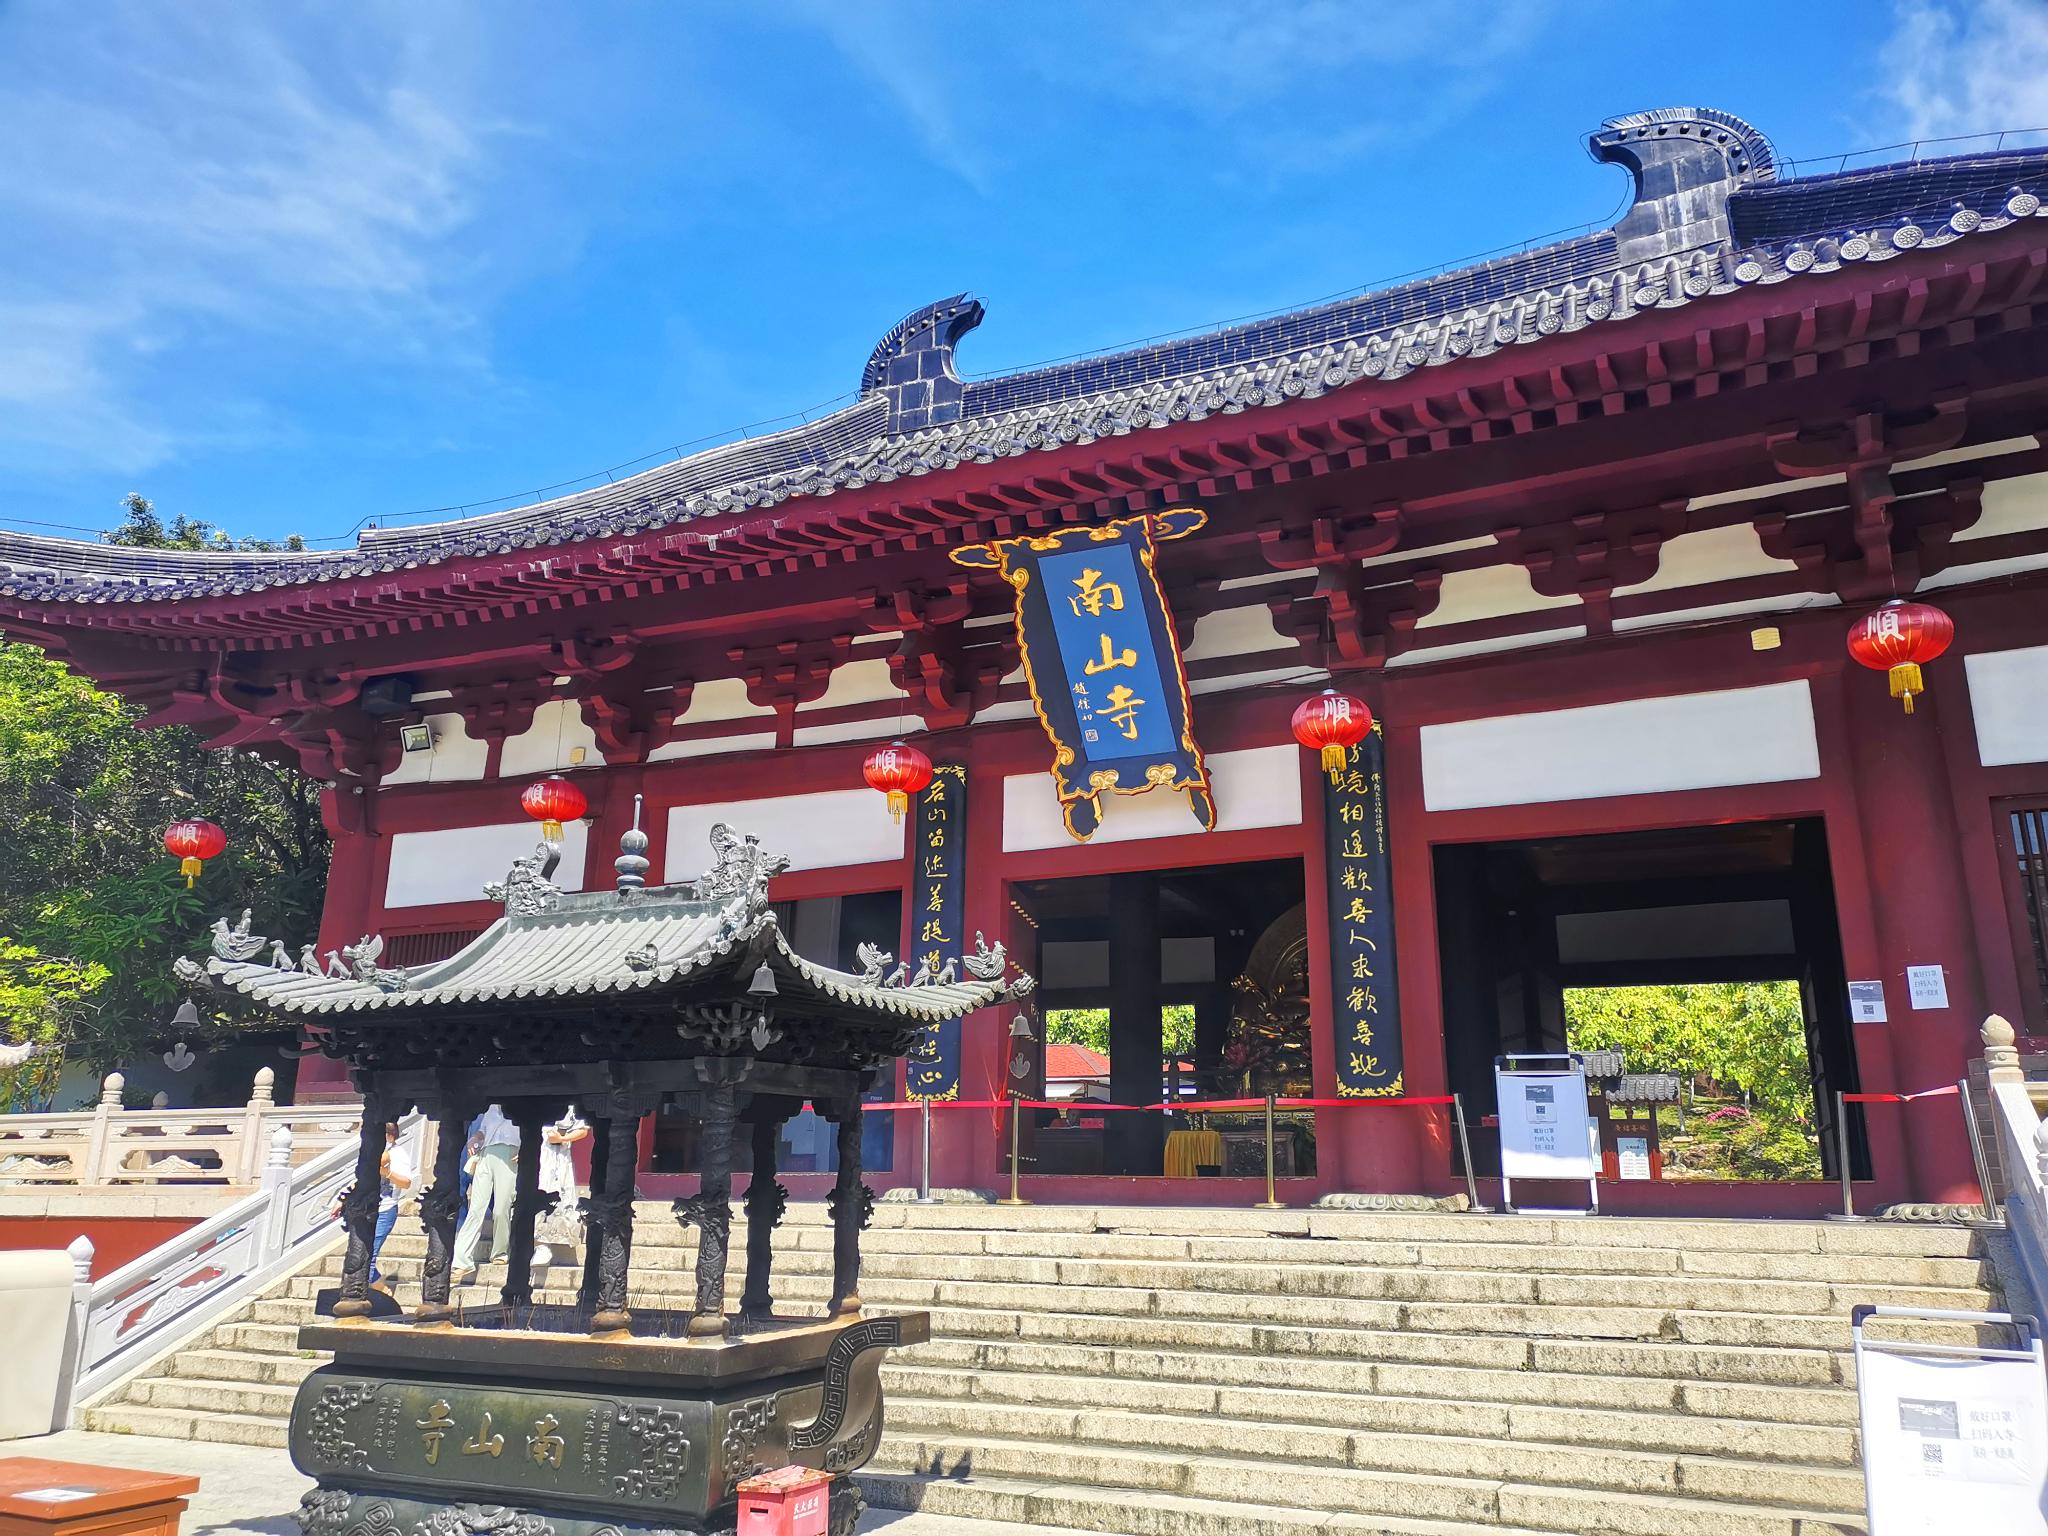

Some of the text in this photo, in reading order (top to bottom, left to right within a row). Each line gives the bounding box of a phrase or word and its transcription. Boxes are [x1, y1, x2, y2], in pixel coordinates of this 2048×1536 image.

[1867, 608, 1906, 645] 順
[1067, 567, 1147, 741] 南山寺
[1323, 697, 1353, 727] 順
[875, 749, 900, 775] 順
[176, 823, 200, 846] 順
[416, 1399, 565, 1470] 南山寺
